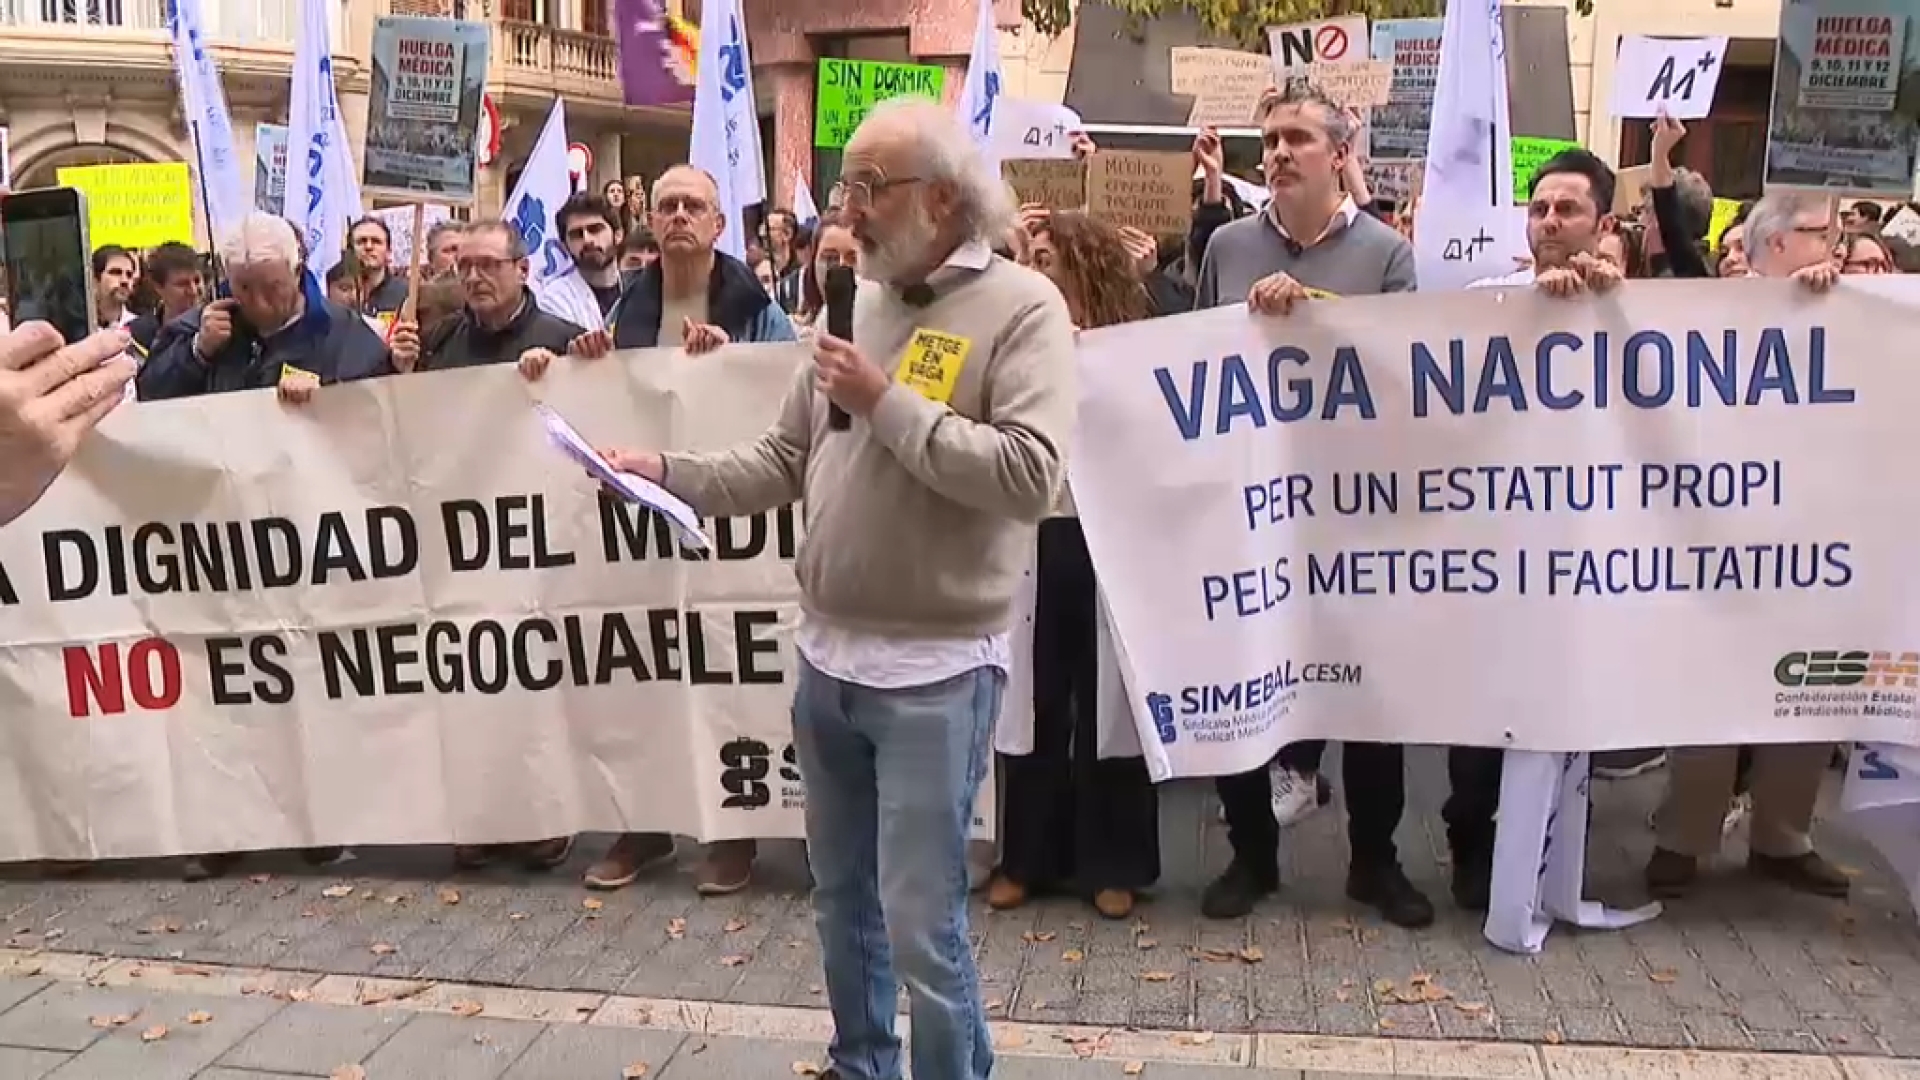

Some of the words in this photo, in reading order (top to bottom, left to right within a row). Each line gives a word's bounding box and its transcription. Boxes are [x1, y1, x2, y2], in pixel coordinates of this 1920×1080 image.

[1816, 16, 1893, 35] HUELGA
[399, 39, 455, 58] HUELGA
[1814, 37, 1891, 57] MÉDICA
[398, 57, 455, 77] MÉDICA
[826, 61, 862, 88] SIN
[1849, 60, 1860, 72] 11
[1865, 60, 1873, 72] Y
[1877, 61, 1890, 73] 12
[1808, 75, 1889, 89] DICIEMBRE
[395, 90, 453, 104] DICIEMBRE
[915, 331, 962, 355] METGE
[922, 349, 944, 365] EN
[908, 360, 944, 384] VAGA
[1153, 346, 1377, 441] VAGA
[1410, 326, 1856, 418] NACIONAL
[1244, 473, 1315, 531] PER
[1332, 471, 1398, 516] UN
[1418, 464, 1623, 513] ESTATUT
[1640, 460, 1781, 509] PROPI
[42, 505, 419, 602] DIGNIDAD
[440, 493, 576, 572] DEL
[1202, 556, 1292, 622] PELS
[1307, 549, 1500, 596] METGES
[1518, 549, 1526, 595] I
[1548, 541, 1853, 596] FACULTATIUS
[62, 637, 182, 718] NO
[205, 634, 295, 705] ES
[317, 608, 785, 700] NEGOCIABLE
[1773, 650, 1920, 687] CESM
[1180, 659, 1301, 715] SIMEBAL
[1302, 663, 1363, 686] CESM
[1774, 690, 1868, 704] Confederación
[1773, 705, 1790, 718] de
[1793, 704, 1860, 718] Sindicatos
